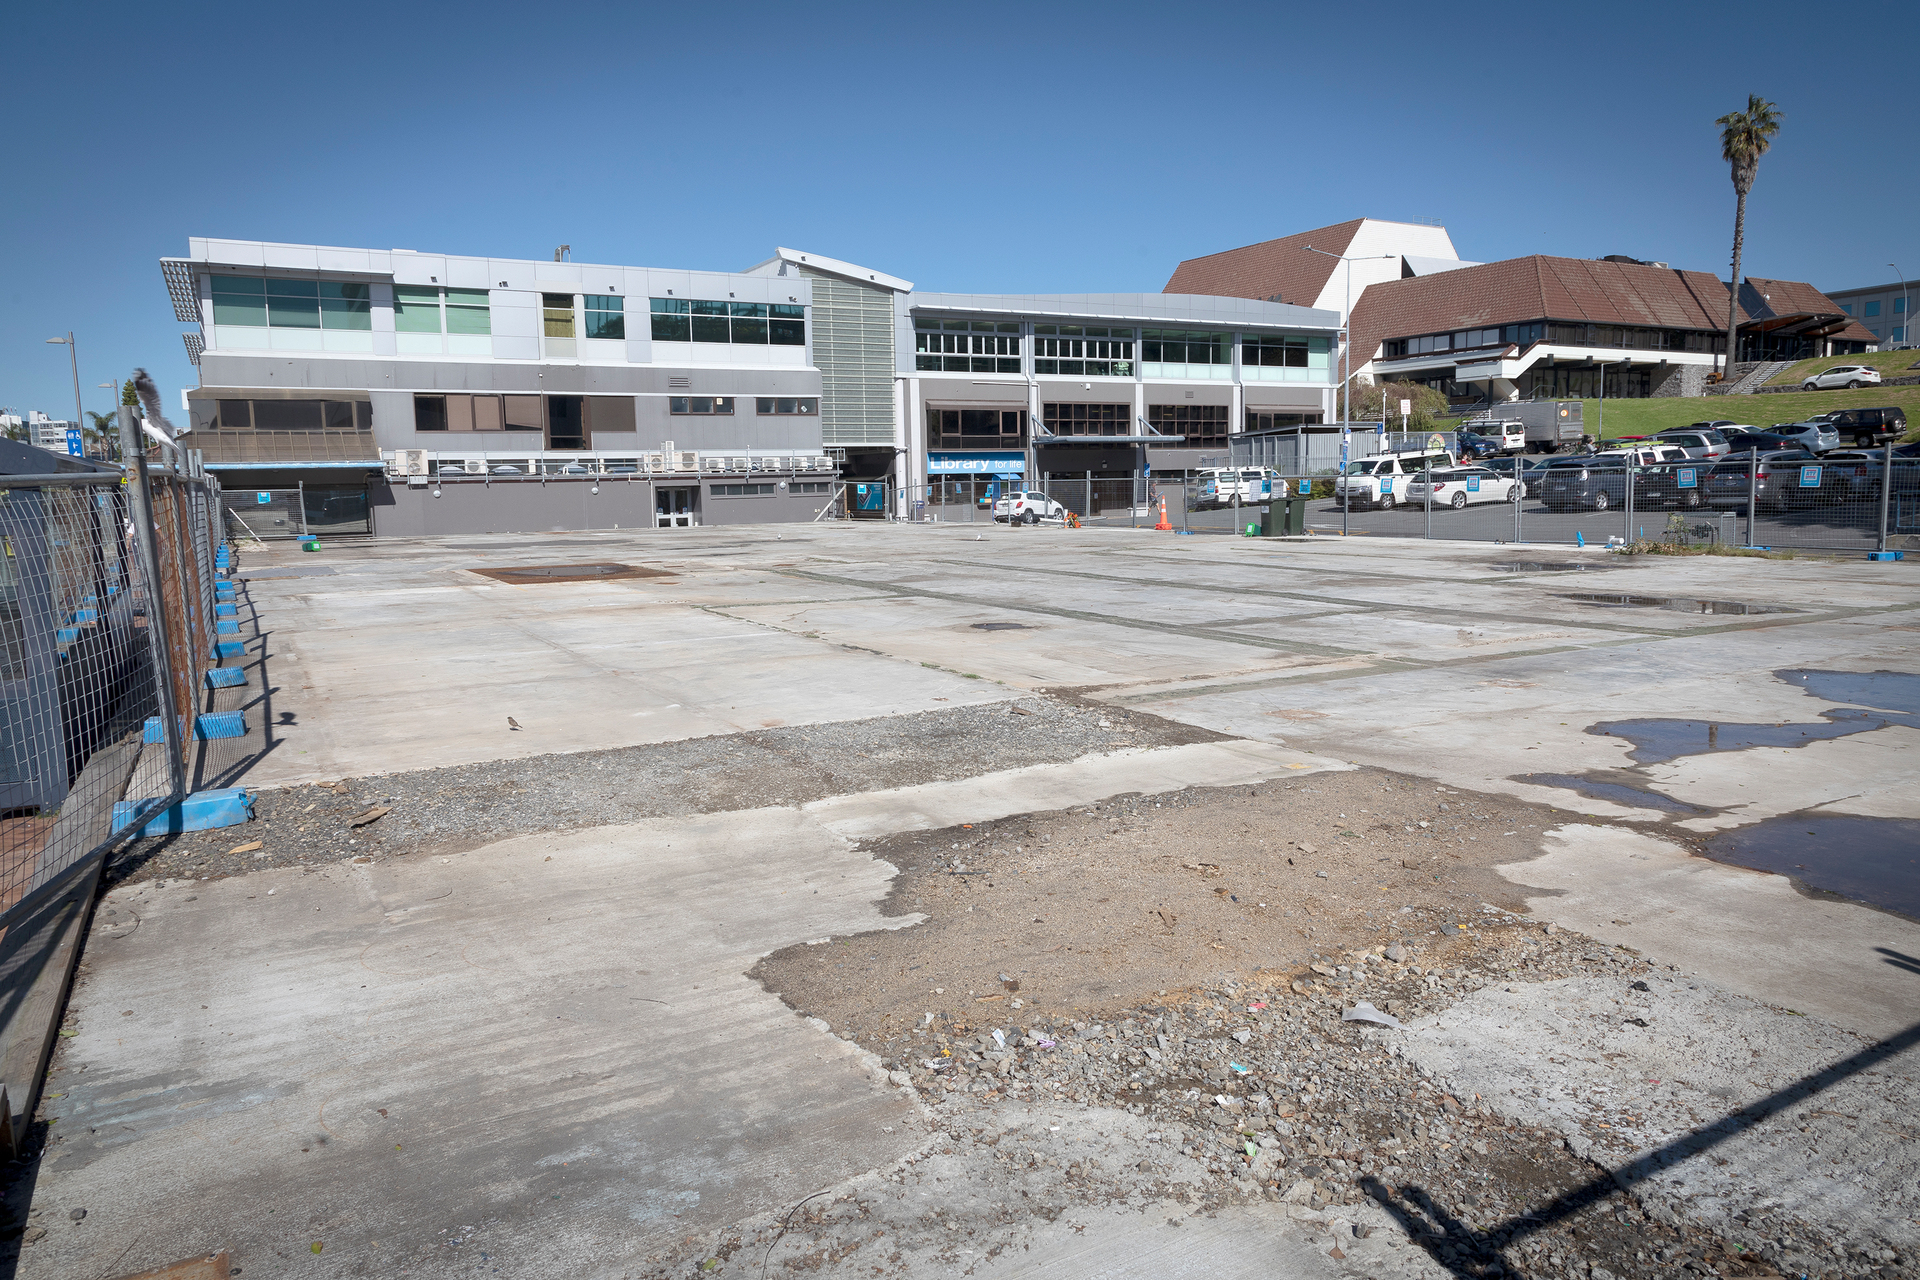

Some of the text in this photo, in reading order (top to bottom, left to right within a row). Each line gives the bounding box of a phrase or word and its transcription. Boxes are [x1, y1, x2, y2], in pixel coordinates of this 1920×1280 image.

[930, 456, 1022, 471] Library for life
